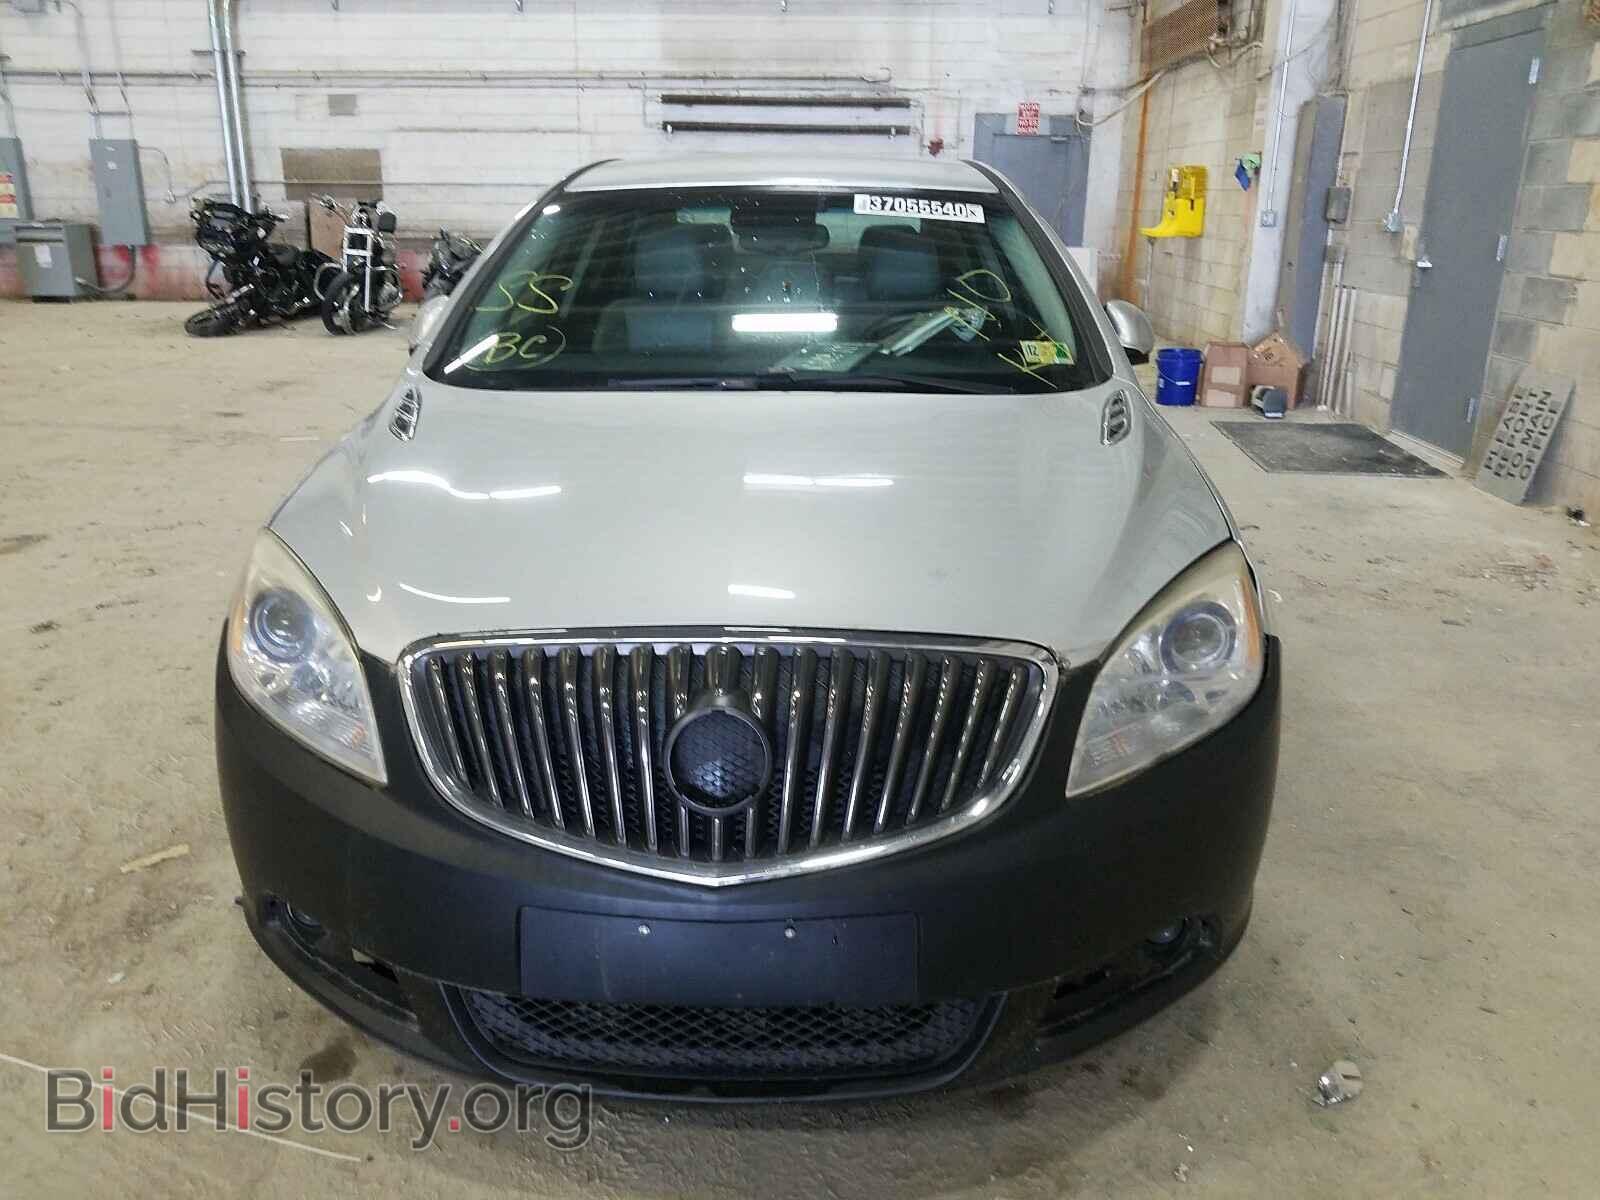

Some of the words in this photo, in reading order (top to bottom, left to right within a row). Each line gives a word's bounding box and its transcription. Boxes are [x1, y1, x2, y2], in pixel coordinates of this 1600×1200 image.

[1484, 385, 1525, 471] PLEASE
[1493, 390, 1538, 478] REPORT
[1505, 452, 1524, 478] TO
[1520, 390, 1553, 446] MAIN
[1519, 404, 1562, 480] OFFICE
